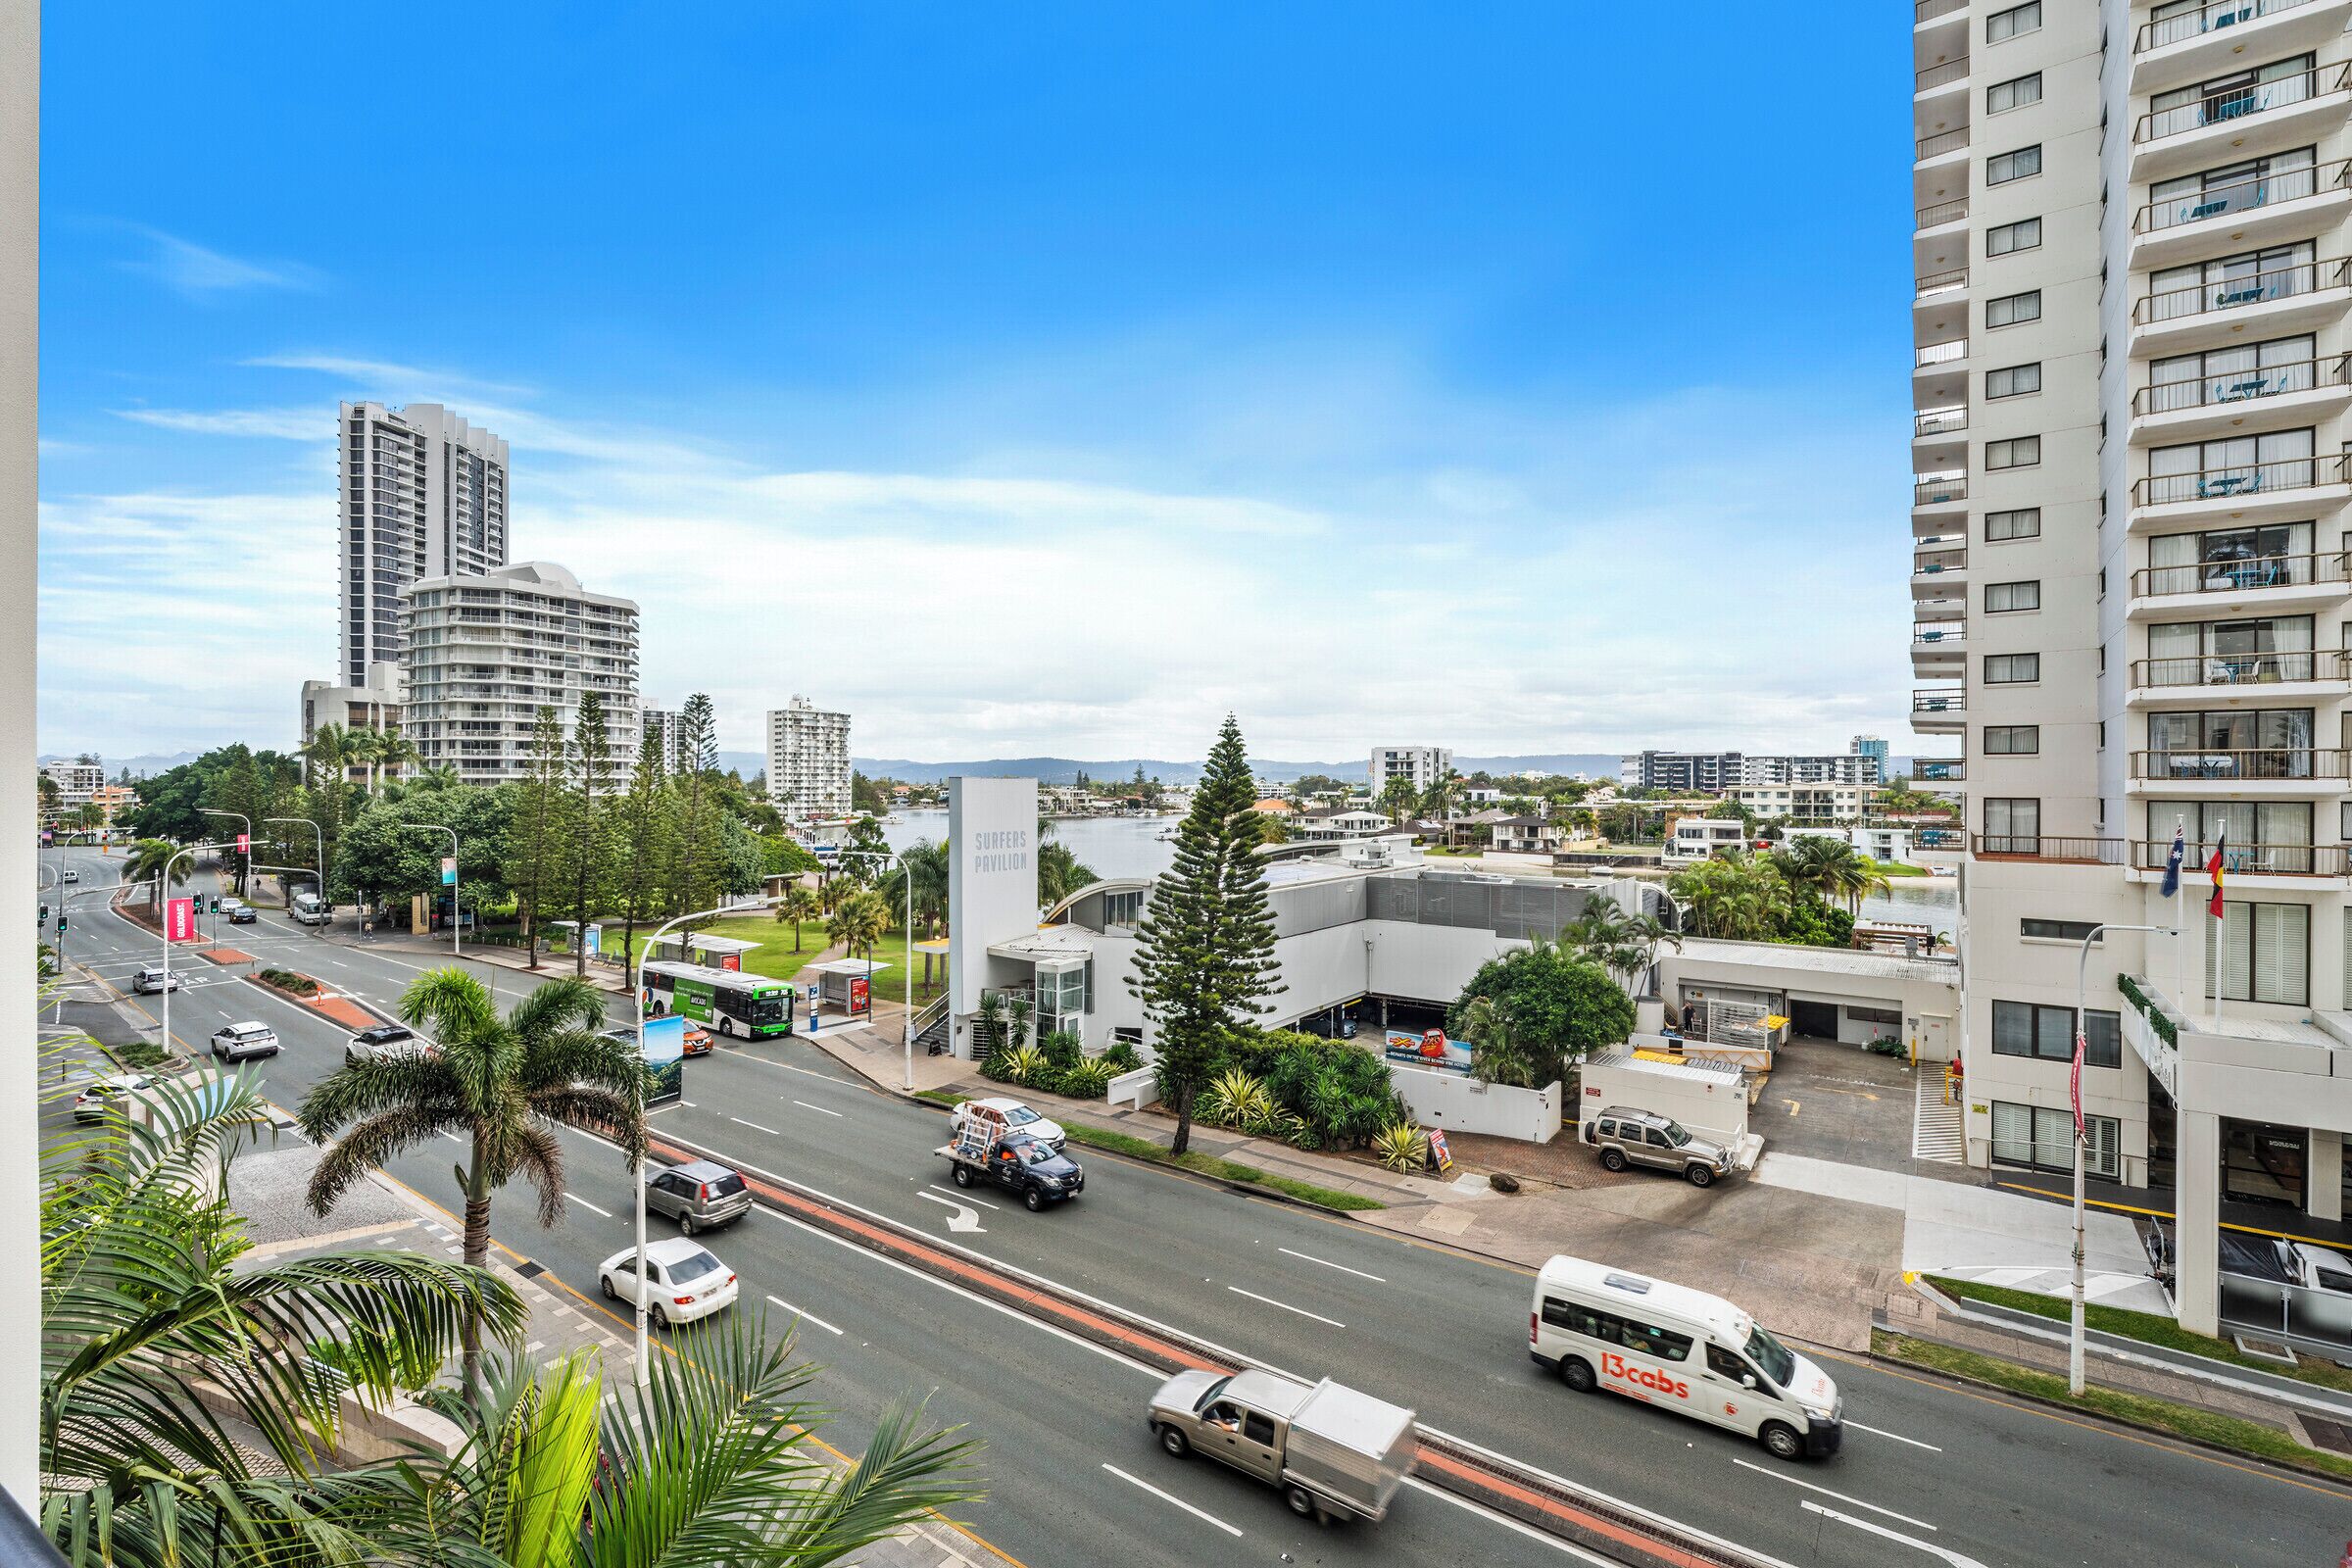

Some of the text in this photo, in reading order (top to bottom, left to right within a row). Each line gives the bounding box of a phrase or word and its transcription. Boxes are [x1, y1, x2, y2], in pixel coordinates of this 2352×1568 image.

[975, 831, 1026, 850] SURFERS
[975, 853, 1027, 873] PAVILION
[1601, 1351, 1690, 1399] 13cabs
